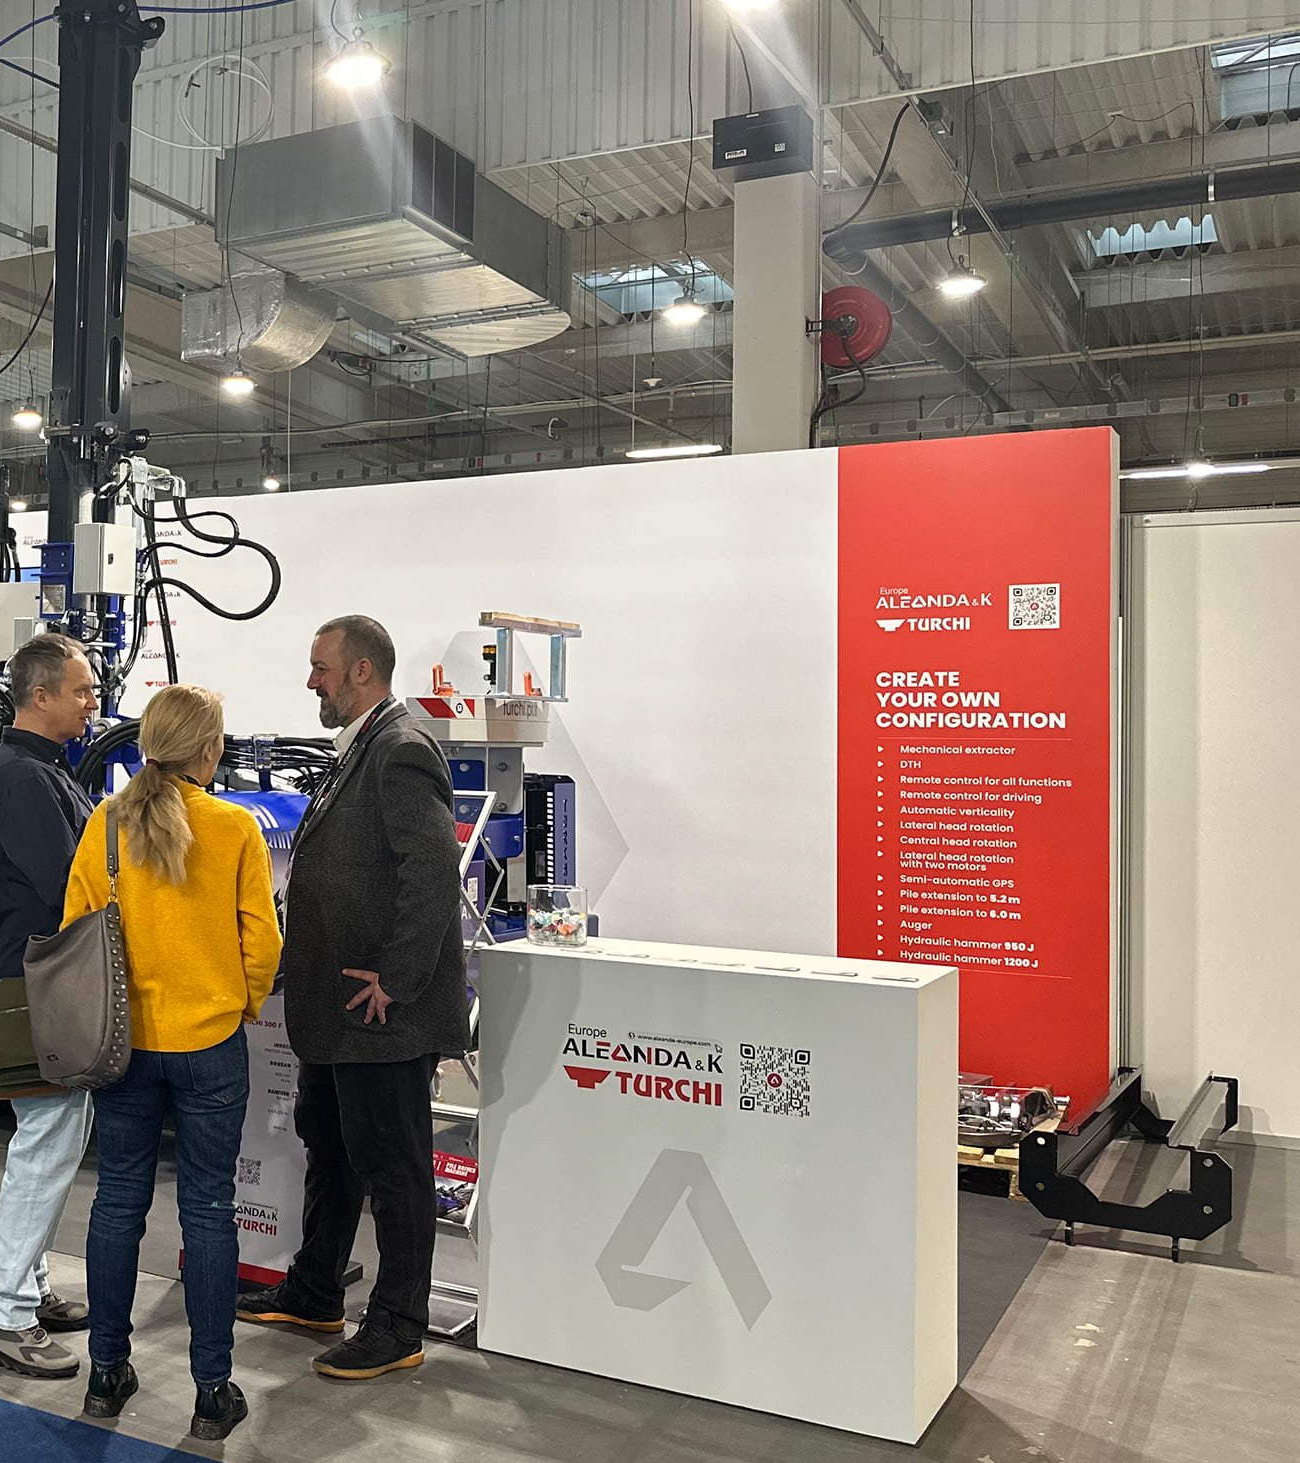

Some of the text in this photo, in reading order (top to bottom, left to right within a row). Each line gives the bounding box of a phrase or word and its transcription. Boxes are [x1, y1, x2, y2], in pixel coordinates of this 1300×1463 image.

[880, 587, 908, 596] Europe
[907, 617, 970, 632] TURCHI
[876, 671, 960, 688] CREATE
[876, 691, 1000, 708] YOUR OWN
[876, 712, 1066, 729] CONFIGURATION
[900, 745, 1016, 755] Mechanical extractor
[900, 760, 922, 769] DTH
[900, 775, 1072, 788] Remote control for all functions
[900, 790, 1042, 805] Remote control for driving
[900, 806, 1014, 820] Automatic verticality
[900, 821, 1014, 833] Lateral head rotation
[900, 836, 1017, 848] Central head rotation
[900, 851, 1014, 864] Lateral head rotation
[900, 860, 987, 872] with two motors
[900, 874, 1014, 888] Semi-automatic GPS
[900, 890, 919, 899] Pile
[921, 890, 974, 902] extension
[976, 893, 988, 902] to
[990, 894, 1008, 904] 5.2
[900, 904, 1022, 920] Pile extension to 6.0 m
[900, 920, 932, 932] Auger
[900, 935, 1035, 952] Hydraulic hammer 950 J
[900, 950, 1039, 968] Hydraulic hammer 1200 J
[568, 1023, 608, 1038] Europe
[614, 1071, 722, 1107] TURCHI
[236, 1218, 278, 1236] TURCHI
